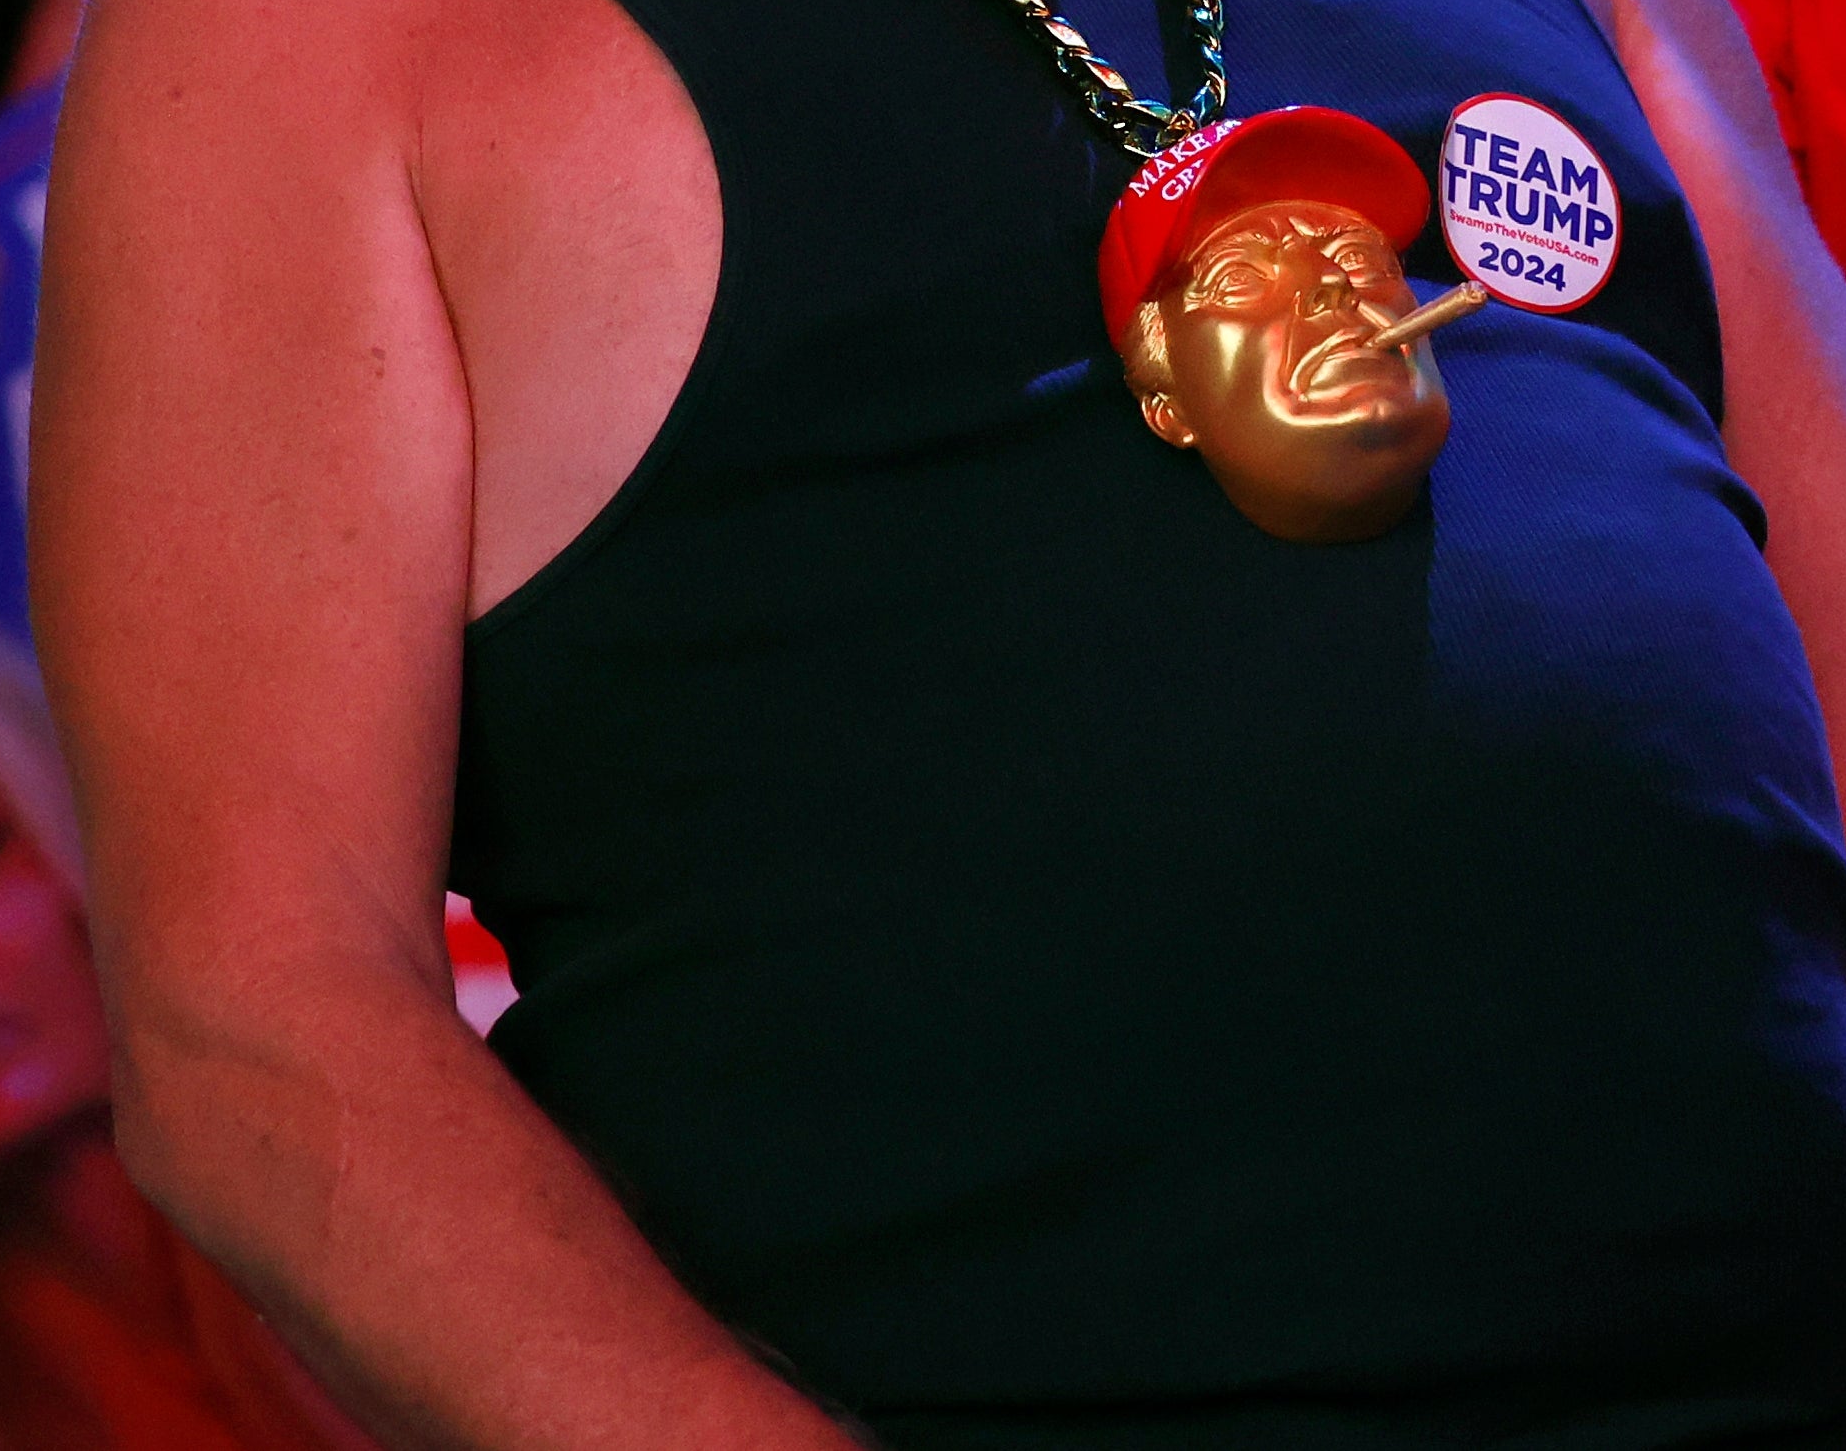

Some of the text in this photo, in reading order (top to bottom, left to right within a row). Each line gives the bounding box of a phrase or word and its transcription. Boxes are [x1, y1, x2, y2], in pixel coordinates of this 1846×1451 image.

[1128, 132, 1212, 198] MAKE
[1454, 122, 1599, 206] TEAM
[1444, 158, 1614, 248] TRUMP
[1449, 208, 1600, 268] SwampTheVoteUSA.com
[1477, 241, 1567, 293] 2024
